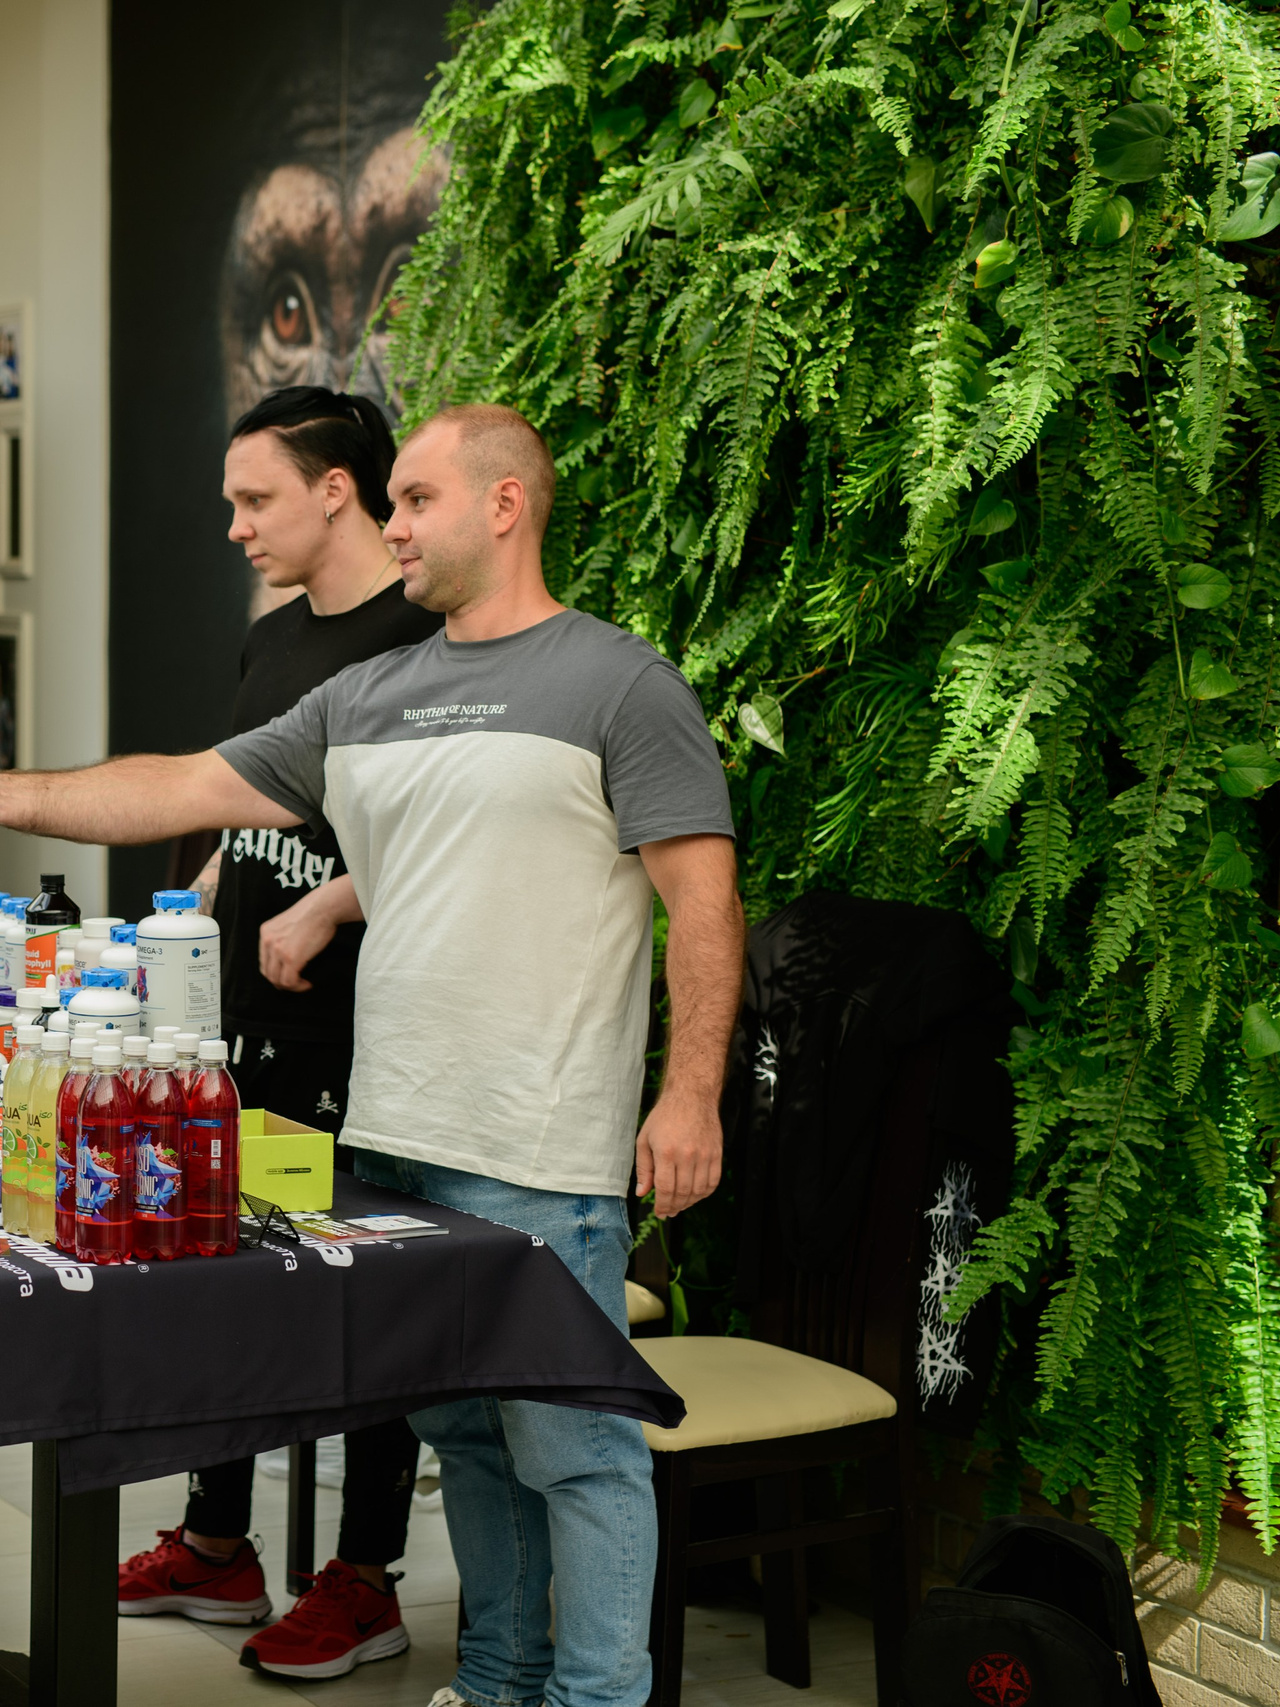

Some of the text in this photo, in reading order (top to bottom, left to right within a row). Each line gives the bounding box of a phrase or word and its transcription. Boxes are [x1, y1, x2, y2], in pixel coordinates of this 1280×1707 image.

[403, 704, 507, 720] RHYTHM OF NATURE
